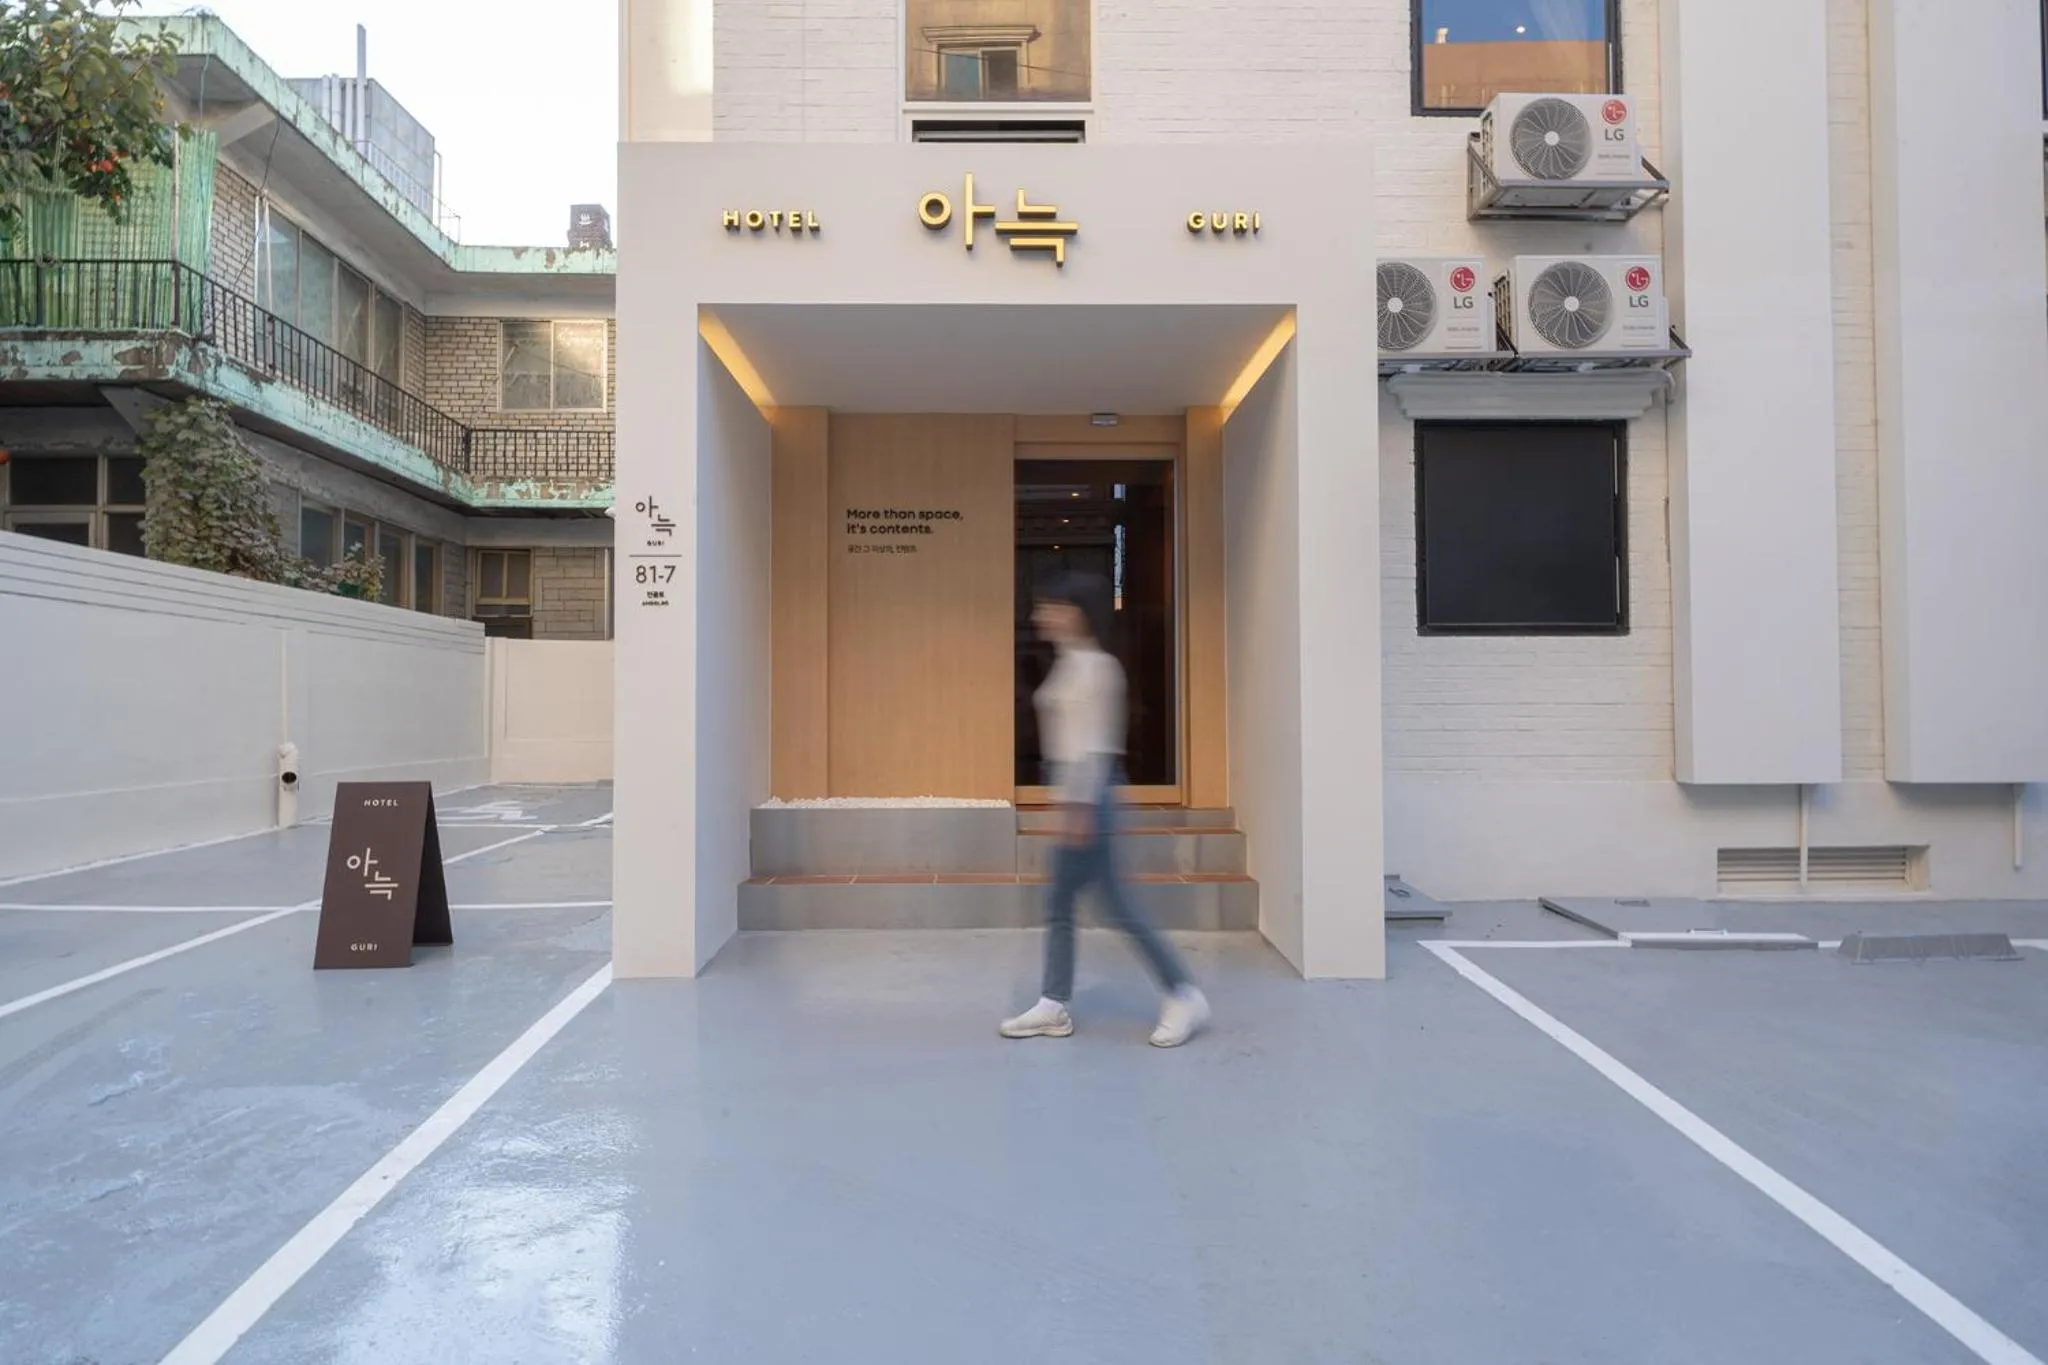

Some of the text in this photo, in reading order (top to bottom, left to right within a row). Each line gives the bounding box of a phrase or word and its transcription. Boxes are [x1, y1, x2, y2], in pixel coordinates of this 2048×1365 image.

[1604, 128, 1625, 142] LG
[722, 172, 1262, 268] HOTEL 아늑 GURI
[1453, 296, 1474, 310] LG
[1628, 295, 1649, 309] LG
[635, 495, 677, 537] 아늑
[846, 509, 964, 521] More than space,
[635, 565, 677, 585] 81-7
[363, 799, 399, 807] HOTEL
[346, 847, 399, 901] 아늑
[351, 943, 379, 951] GURI
